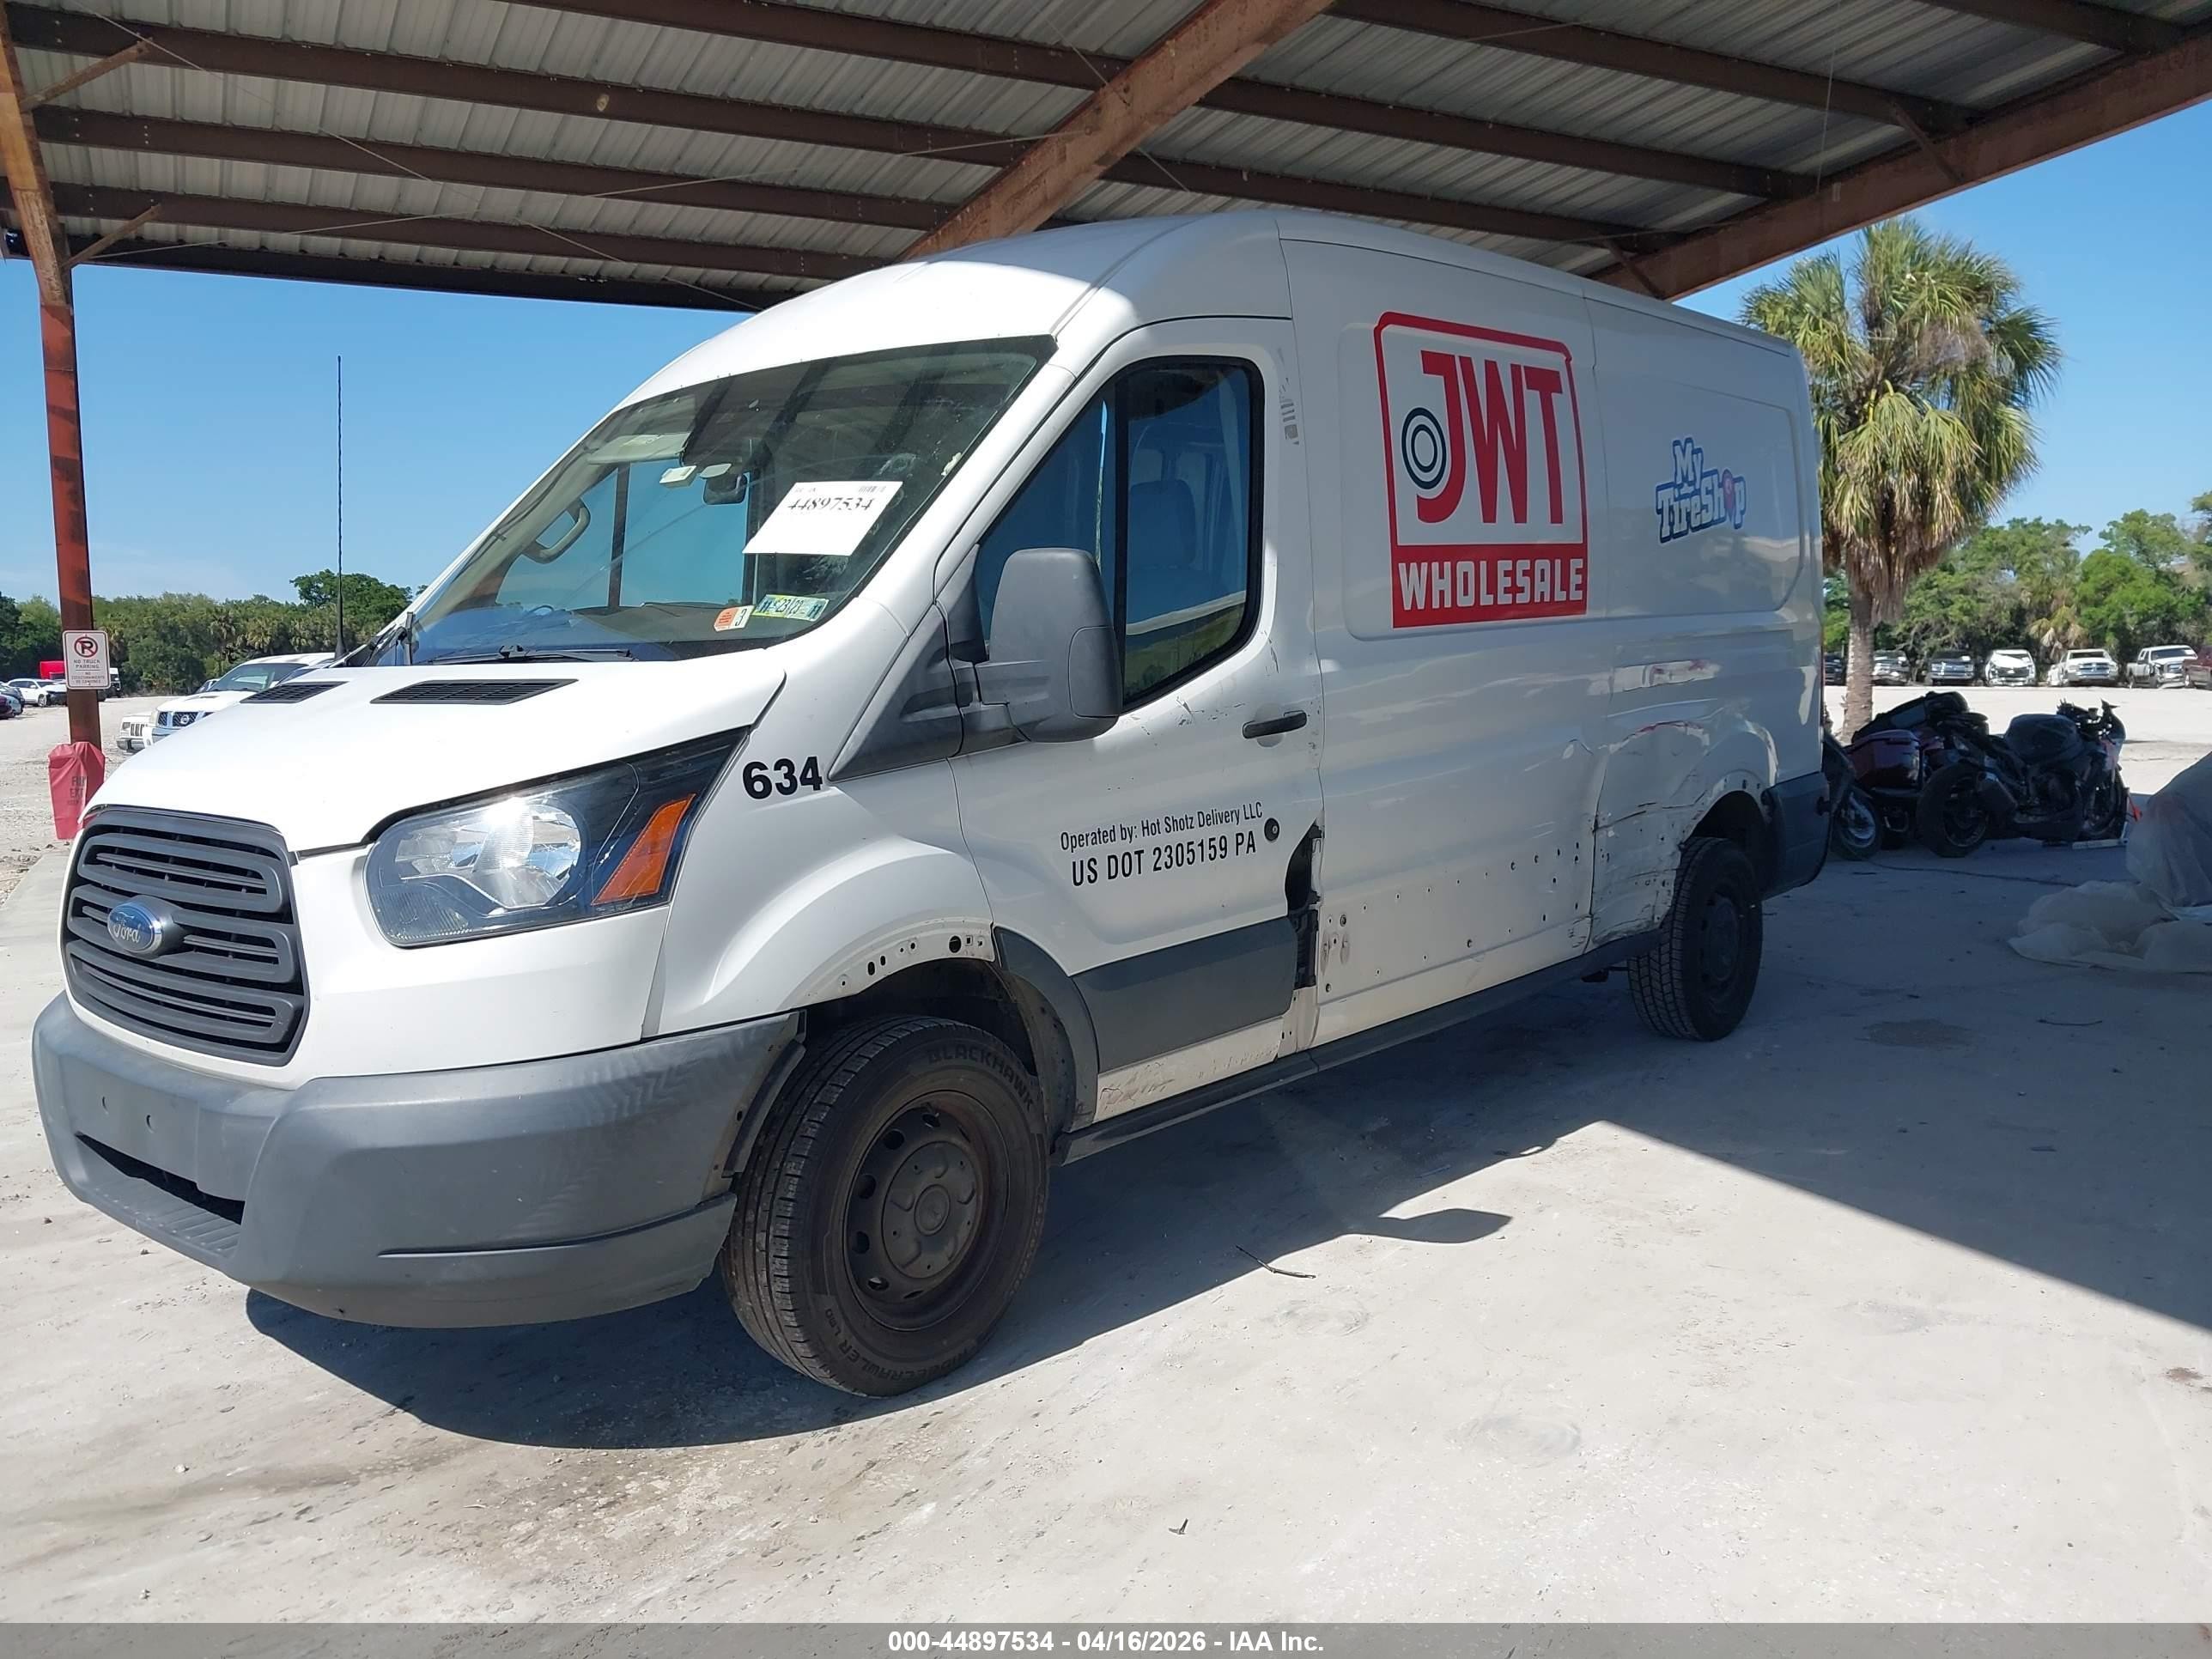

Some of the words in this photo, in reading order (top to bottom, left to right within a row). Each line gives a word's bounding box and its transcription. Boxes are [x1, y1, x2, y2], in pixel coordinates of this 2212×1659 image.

[1417, 349, 1564, 525] JWT
[1673, 437, 1704, 490] My
[787, 497, 875, 511] 44897534
[1398, 558, 1583, 611] WHOLESALE
[743, 757, 823, 799] 634
[1060, 825, 1115, 853] Operated
[1121, 823, 1138, 844] by:
[1141, 818, 1161, 837] Hot
[1165, 814, 1194, 833] Shotz
[1197, 807, 1240, 828] Delivery
[1243, 801, 1263, 820] LLC
[1073, 857, 1098, 886] US
[1107, 849, 1145, 879] DOT
[1152, 835, 1228, 872] 2305159
[1236, 830, 1256, 856] PA
